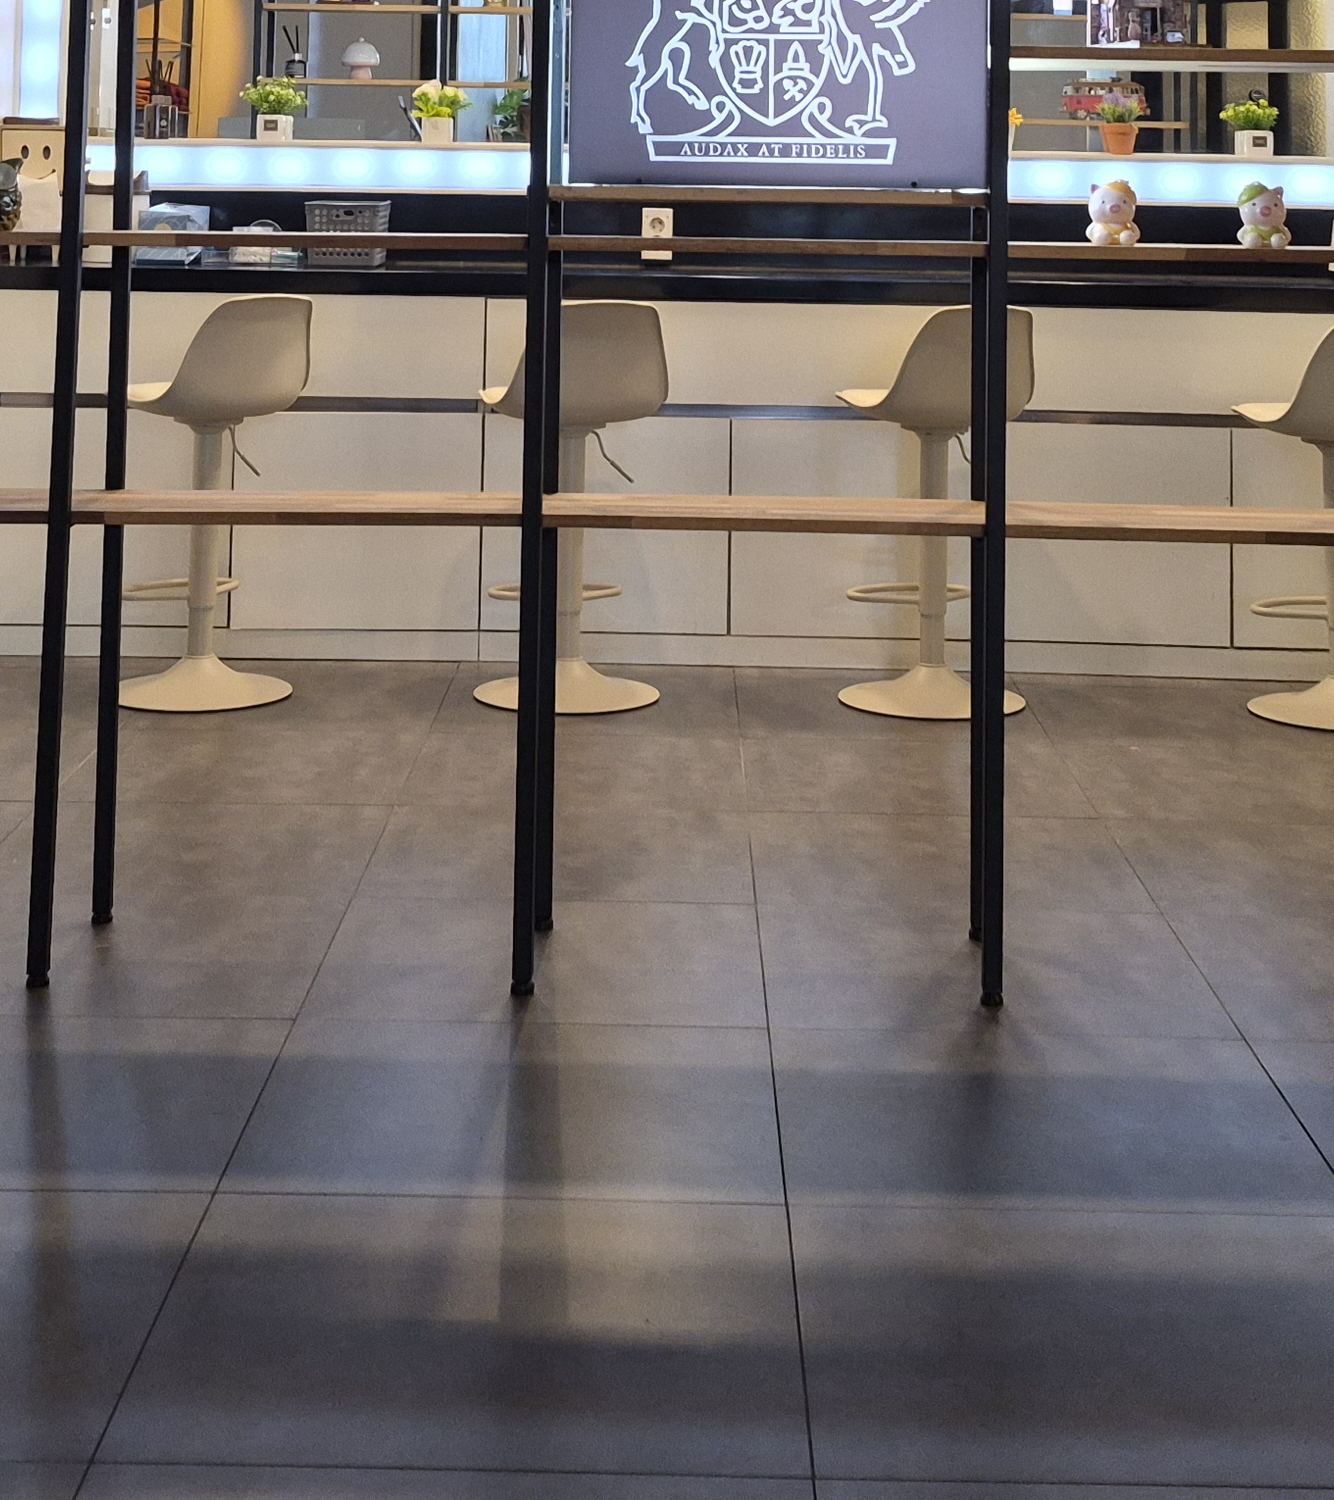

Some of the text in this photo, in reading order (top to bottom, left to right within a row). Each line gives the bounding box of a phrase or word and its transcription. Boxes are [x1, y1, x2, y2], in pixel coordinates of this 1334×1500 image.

[679, 142, 867, 159] AUDAX AT FIDELIS
